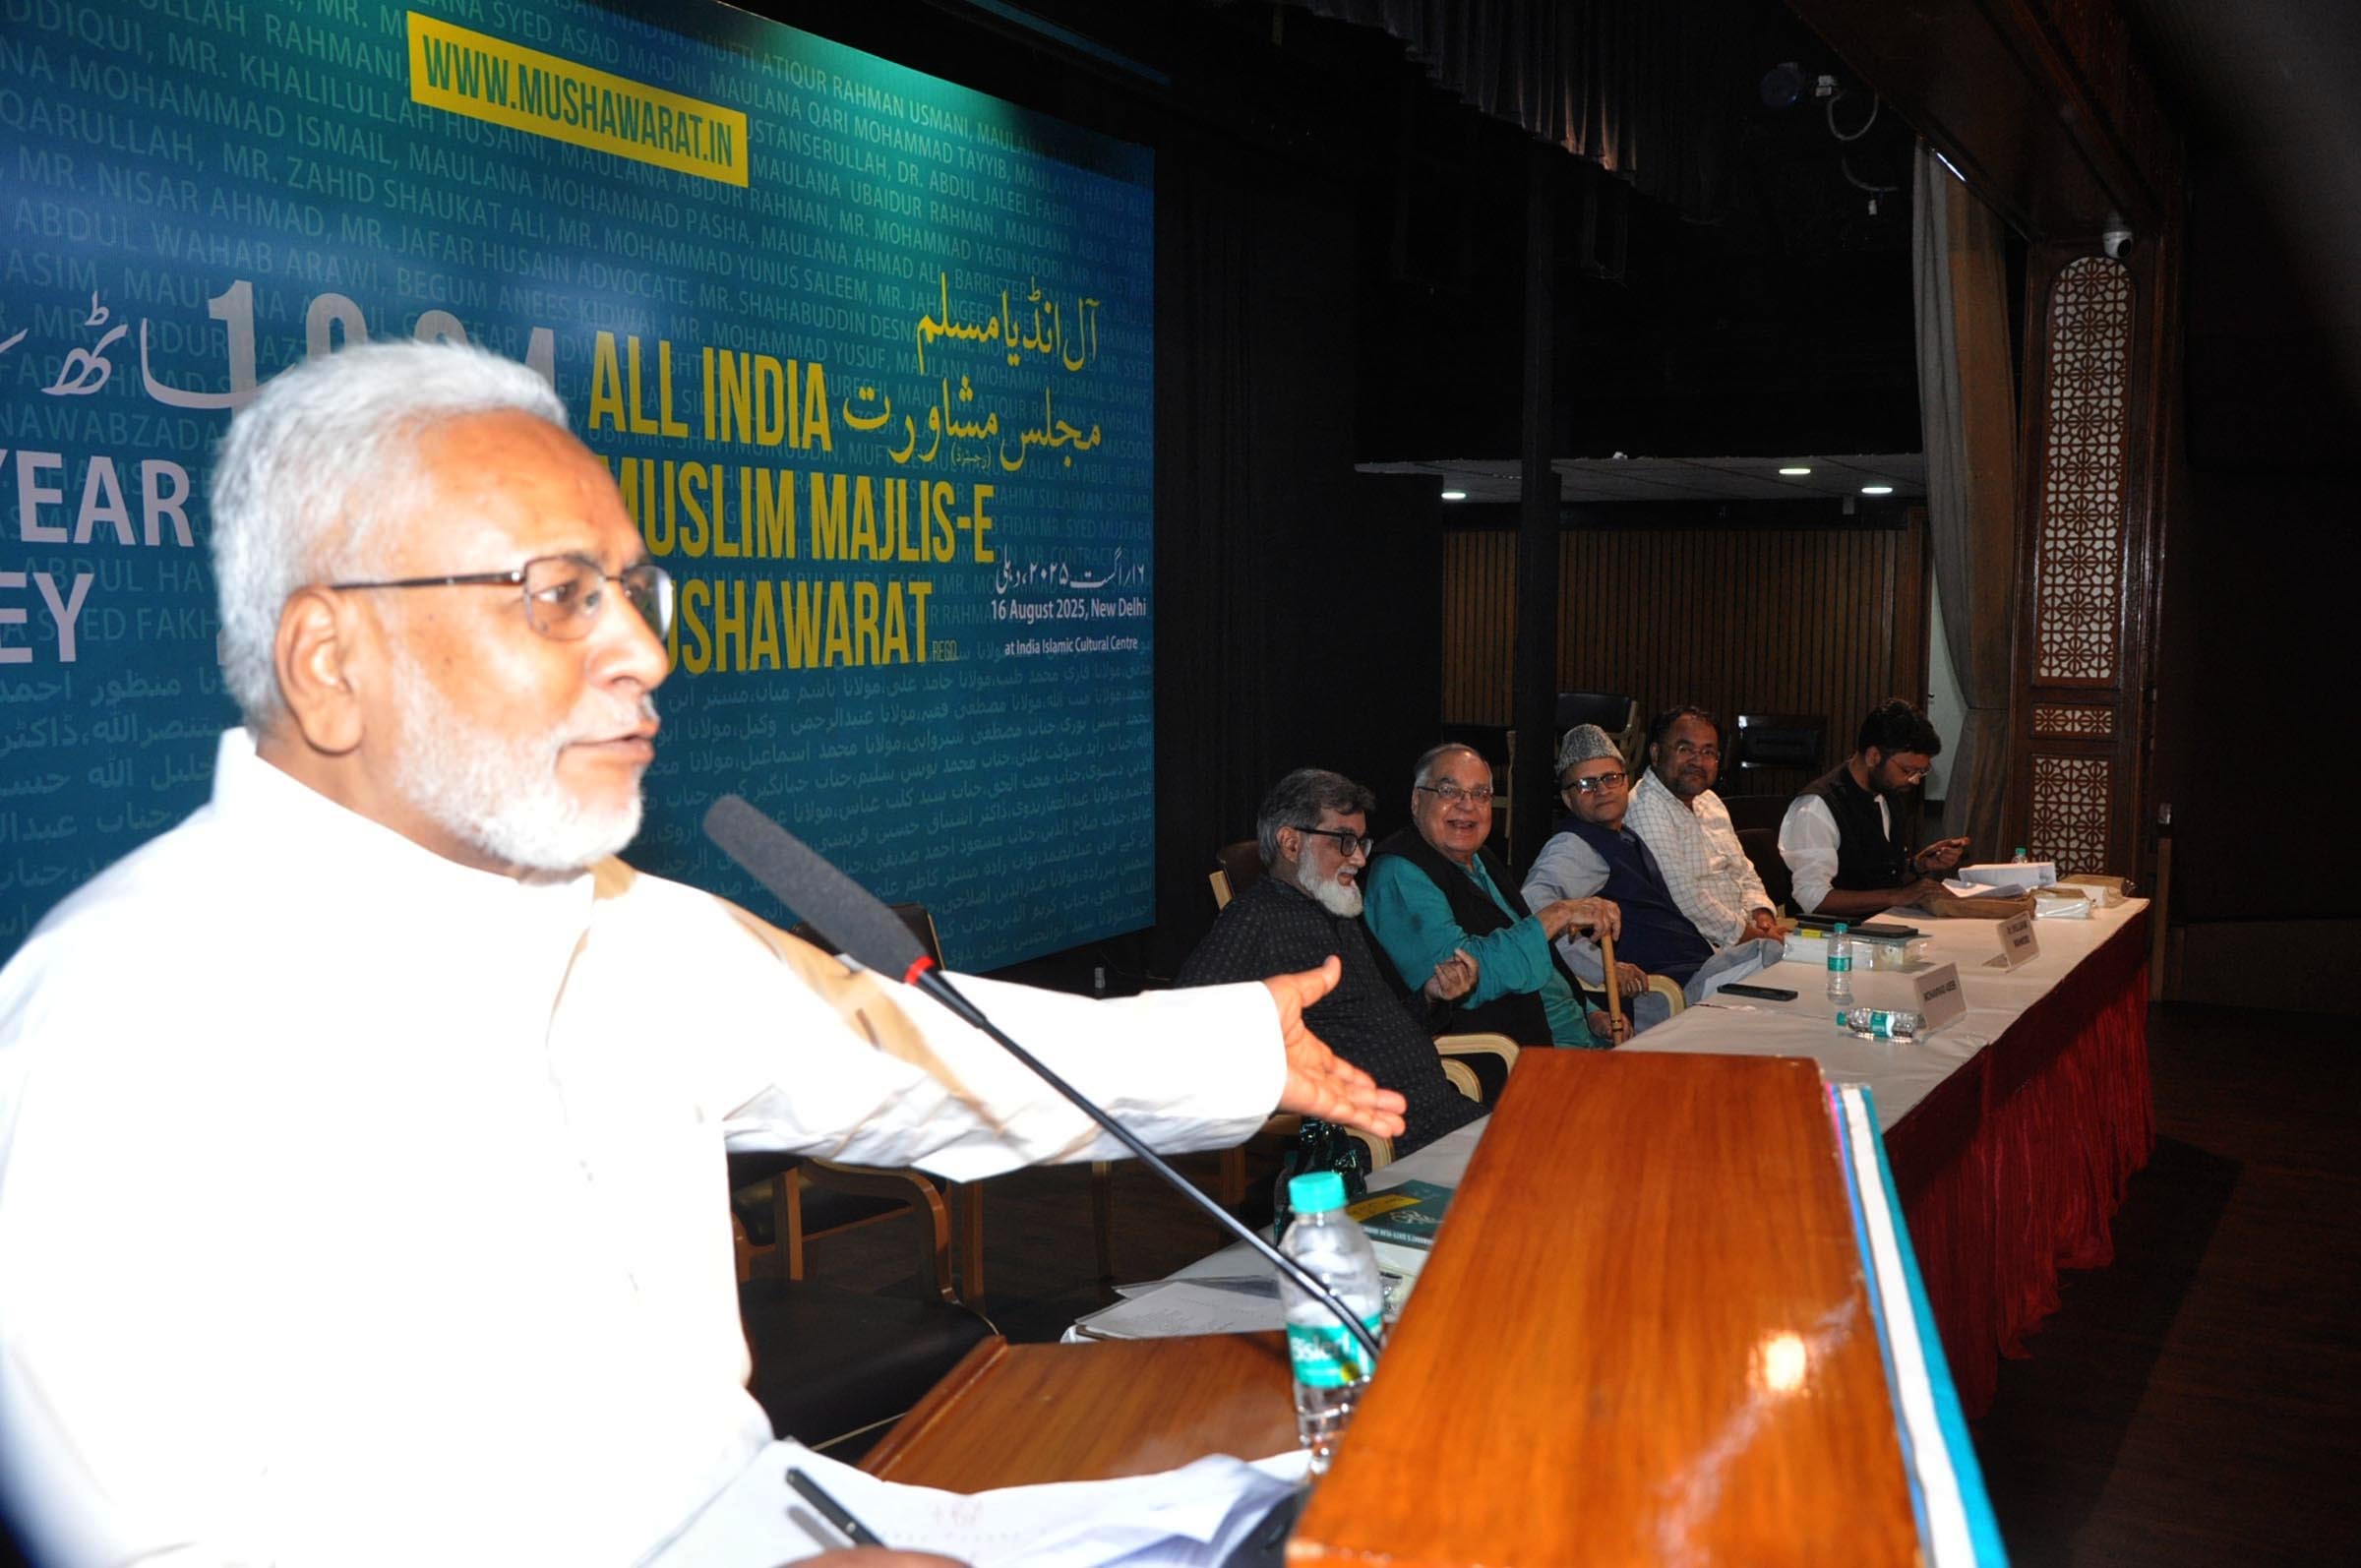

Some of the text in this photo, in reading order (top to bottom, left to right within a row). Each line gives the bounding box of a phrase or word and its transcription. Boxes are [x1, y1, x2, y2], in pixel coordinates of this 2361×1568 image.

[265, 13, 408, 88] RAHMANI,
[753, 153, 842, 200] MAULANA
[850, 180, 923, 219] UBAIDUR
[930, 200, 999, 239] RAHMAN,
[1005, 219, 1071, 255] MAULANA
[423, 33, 734, 167] WWW.MUSHAWARAT.IN
[493, 2, 551, 42] SYED
[561, 24, 621, 64] ASAD
[629, 44, 703, 92] MADNI,
[709, 70, 802, 121] MAULANA
[808, 101, 849, 135] QARI
[854, 115, 953, 164] MOHAMMAD
[957, 146, 1012, 184] TAYYIB,
[762, 53, 827, 95] ATIQUR
[833, 75, 904, 118] RAHMAN
[909, 99, 973, 143] USMANI,
[69, 53, 286, 139] MOHAMMAD
[297, 112, 399, 172] ISMAIL,
[409, 141, 534, 198] MAULANA
[542, 175, 680, 229] MOHAMMAD
[687, 208, 756, 251] PASHA,
[761, 225, 849, 268] MAULANA
[853, 246, 914, 278] AHMAD
[167, 31, 228, 79] MR.
[239, 51, 436, 134] KHALILULLAH
[561, 141, 670, 192] MAULANA
[677, 172, 744, 208] ABDUR
[750, 187, 834, 233] RAHMAN,
[839, 210, 870, 238] MR.
[874, 219, 972, 261] MOHAMMAD
[976, 240, 1018, 272] YASIN
[897, 160, 924, 188] DR.
[929, 170, 979, 204] ABDUL
[983, 186, 1030, 216] JALEEL
[19, 144, 87, 193] MR.
[98, 161, 199, 212] NISAR
[211, 187, 333, 245] AHMAD,
[341, 211, 391, 251] MR.
[397, 224, 475, 267] JAFAR
[482, 241, 571, 284] HUSAIN
[577, 261, 695, 307] ADVOCATE,
[699, 283, 735, 313] MR.
[739, 290, 867, 335] SHAHABUDDIN
[223, 141, 278, 185] MR.
[286, 155, 377, 205] ZAHID
[384, 178, 504, 230] SHAUKAT
[510, 208, 552, 245] ALI,
[558, 215, 598, 251] MR.
[604, 226, 733, 276] MOHAMMAD
[738, 253, 800, 289] YUNUS
[804, 268, 874, 308] SALEEM,
[877, 282, 906, 309] MR.
[15, 196, 140, 252] ABDUL
[151, 220, 273, 275] WAHAB
[283, 247, 387, 297] ARAWI,
[395, 266, 488, 308] BEGUM
[497, 284, 571, 322] ANEES
[671, 314, 706, 344] MR.
[713, 324, 828, 362] MOHAMMAD
[833, 341, 891, 374] YUSUF,
[976, 366, 1059, 394] MOHAMMAD
[916, 272, 1000, 376] مسلم
[588, 331, 689, 440] ALL
[702, 345, 834, 452] INDIA
[843, 376, 999, 465] مشاورت
[999, 387, 1102, 472] مجلس
[0, 449, 195, 548] EAR
[810, 471, 997, 565] MAJLIS-E
[1065, 517, 1097, 540] SYED
[36, 607, 127, 641] SED
[991, 596, 1147, 625] 16 August 2025, New Delhi
[1004, 634, 1138, 656] at India Islamic Cultural Centre
[90, 669, 182, 707] منظور
